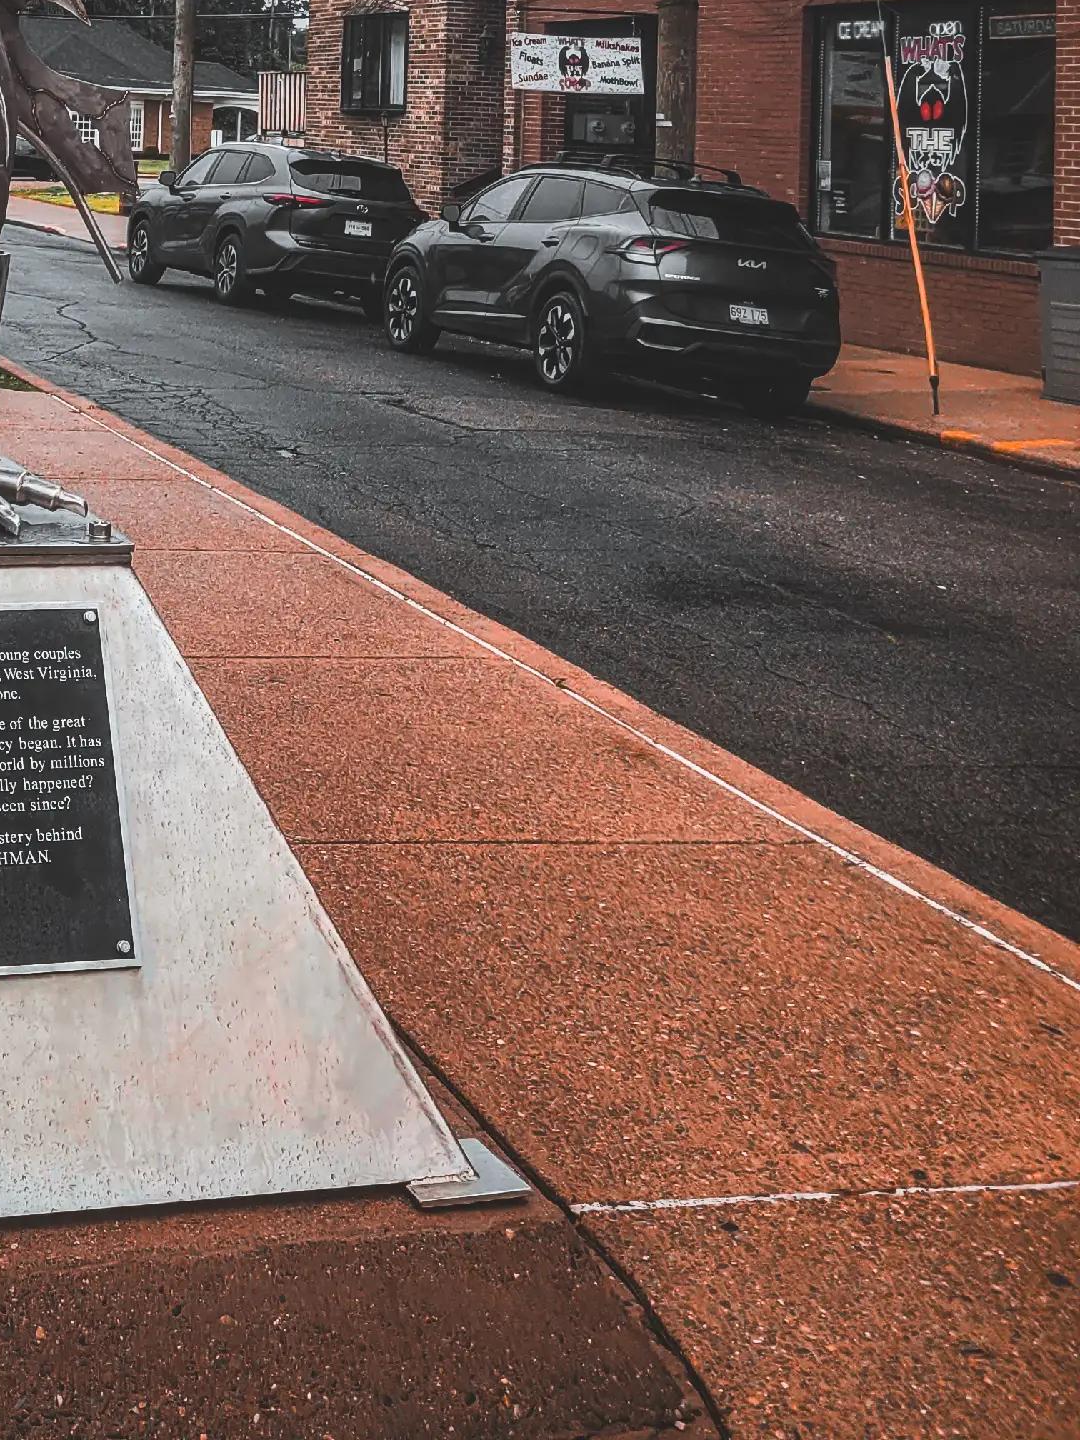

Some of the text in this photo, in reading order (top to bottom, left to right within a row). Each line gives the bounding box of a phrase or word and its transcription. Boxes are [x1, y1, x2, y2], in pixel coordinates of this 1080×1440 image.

[524, 37, 547, 46] Cream
[595, 39, 640, 53] Milkshakes
[519, 51, 544, 66] Floats
[591, 60, 620, 70] Banana
[518, 71, 549, 83] Sundae
[906, 127, 955, 152] THE
[33, 646, 81, 663] couples
[3, 667, 35, 680] West
[9, 716, 24, 730] of
[28, 715, 49, 730] the
[52, 715, 86, 732] great
[18, 736, 62, 753] began.
[66, 735, 76, 748] It
[79, 734, 102, 748] has
[29, 756, 46, 773] by
[50, 754, 105, 770] millions
[23, 774, 93, 794] happened?
[30, 796, 71, 812] since?
[36, 827, 83, 842] behind
